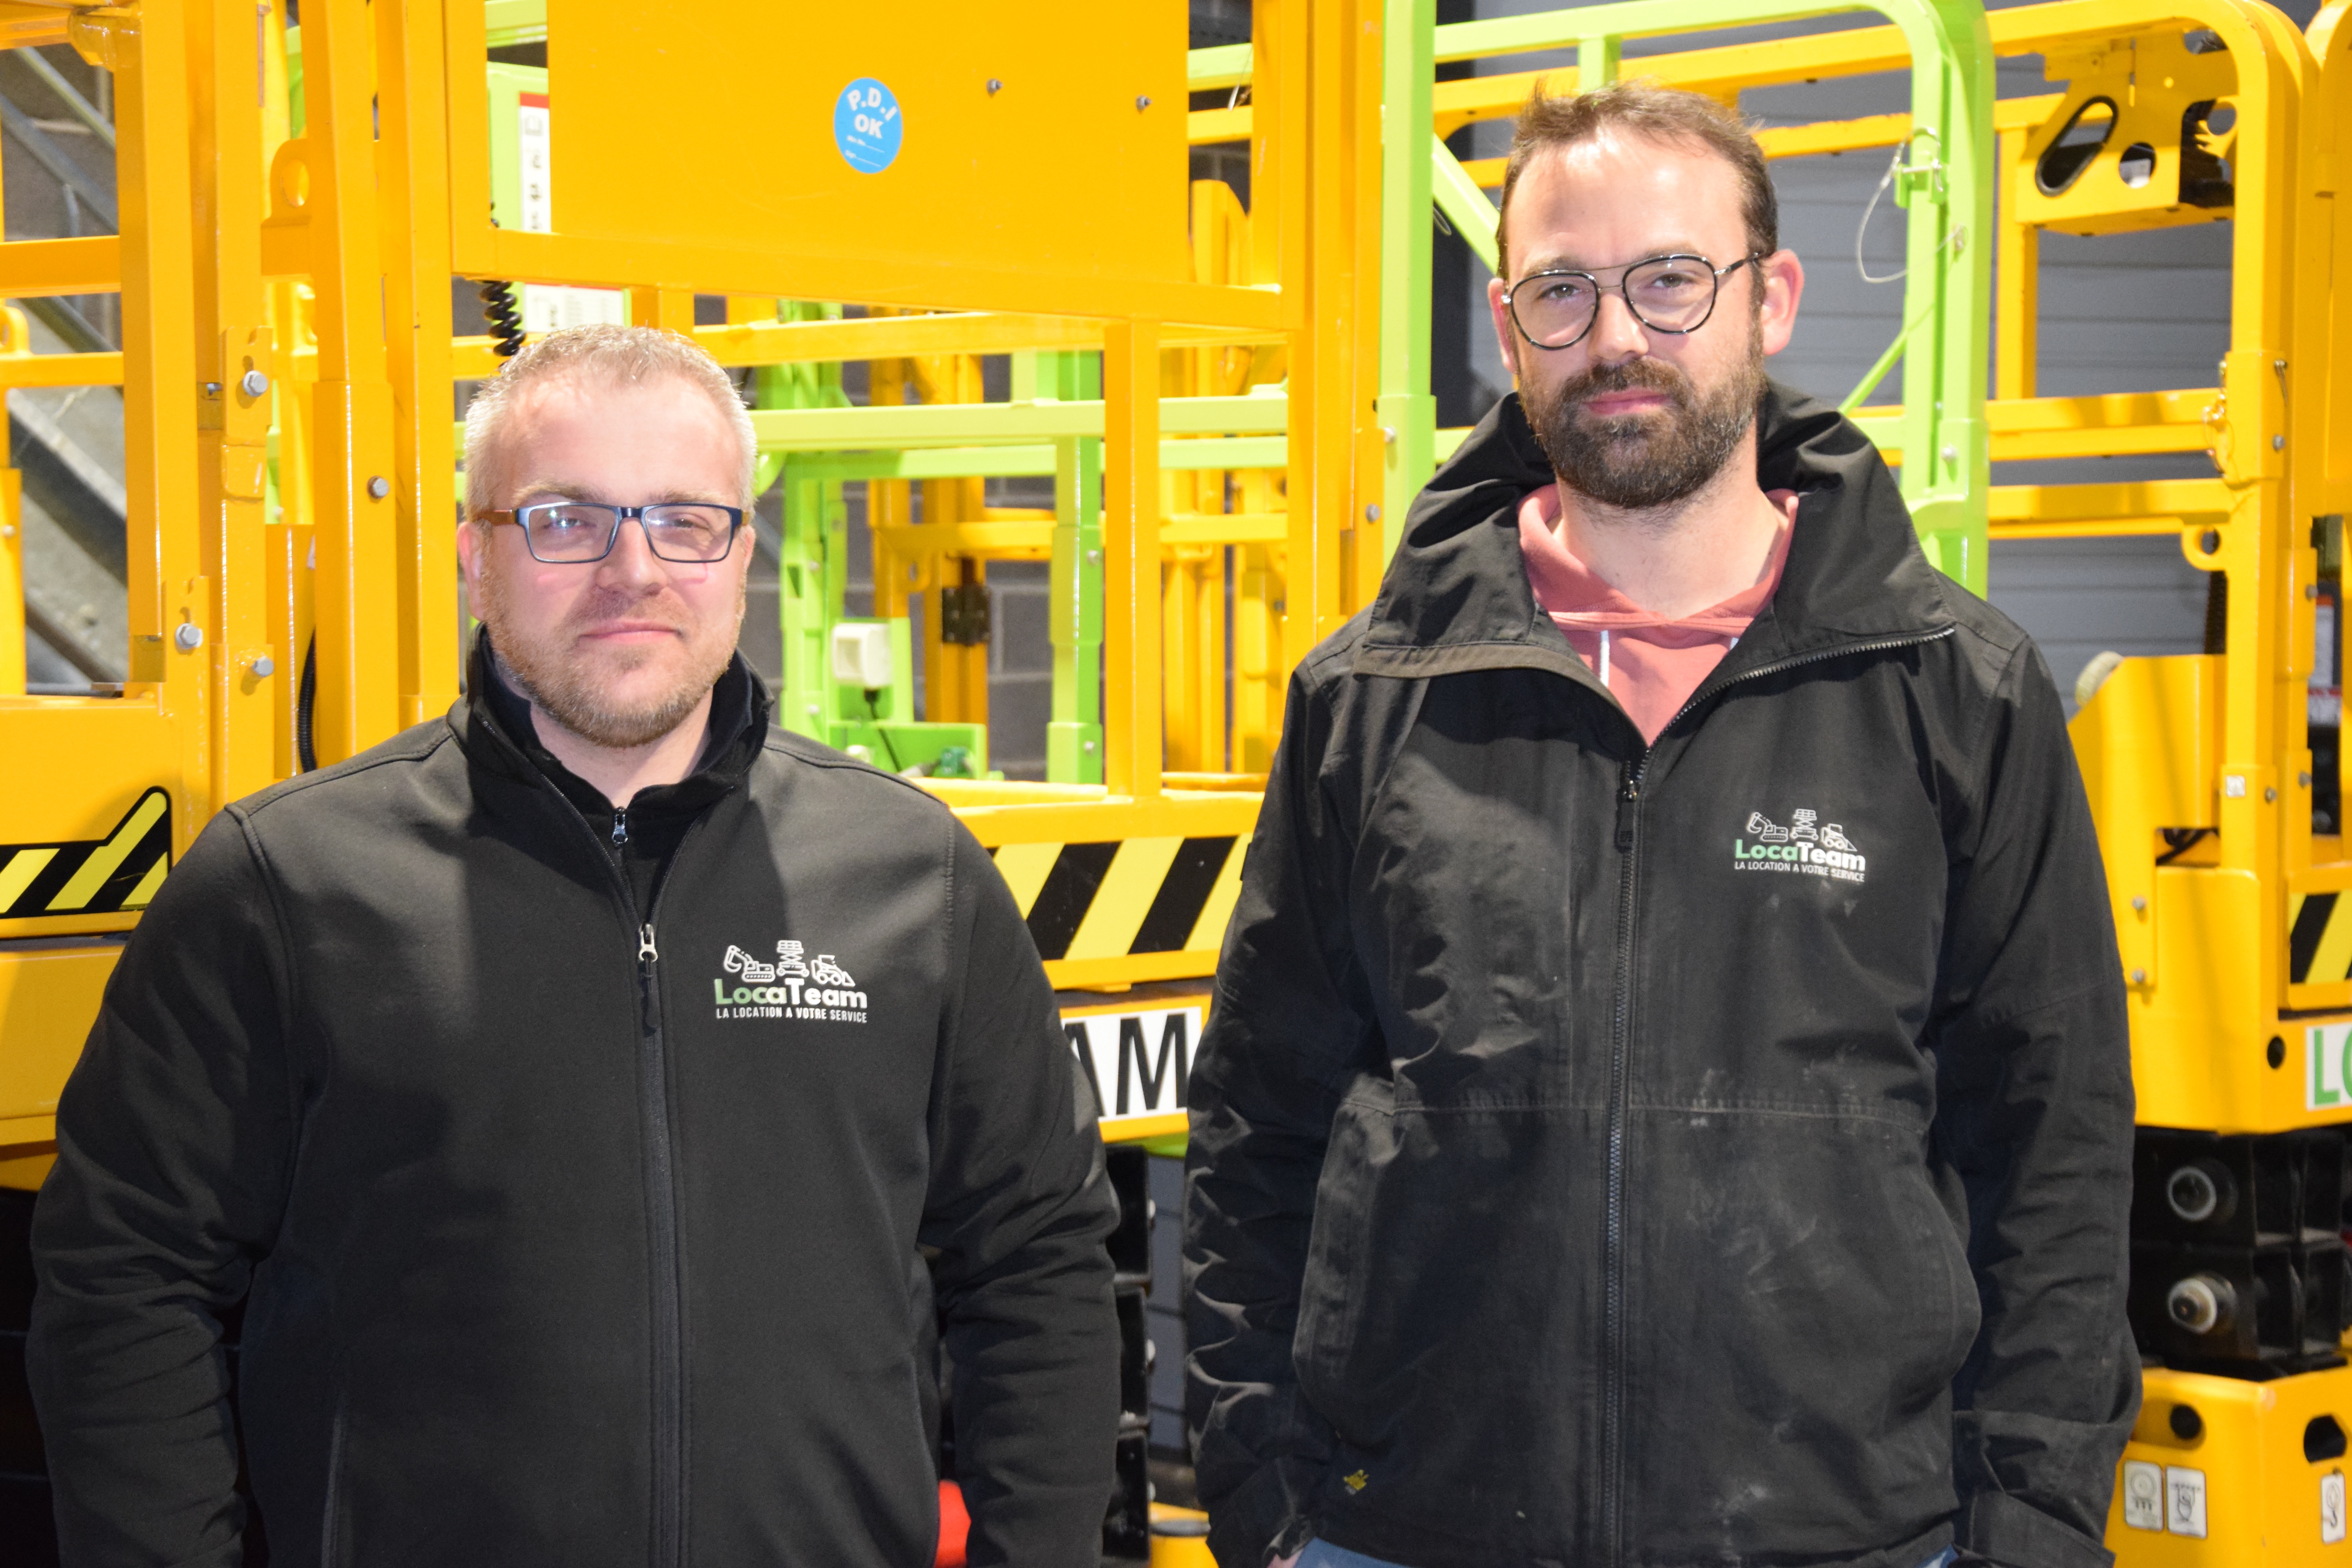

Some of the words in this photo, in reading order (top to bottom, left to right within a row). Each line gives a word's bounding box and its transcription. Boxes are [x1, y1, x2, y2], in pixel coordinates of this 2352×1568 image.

[854, 113, 884, 139] OK
[1735, 838, 1866, 871] LocaTeam
[1735, 861, 1746, 870] LA
[1748, 861, 1791, 872] LOCATION
[1793, 864, 1799, 872] A
[1803, 864, 1829, 876] VOTRE
[1831, 869, 1865, 882] SERVICE
[714, 978, 867, 1009] LocaTeam
[716, 1008, 730, 1019] LA
[733, 1007, 782, 1018] LOCATION
[786, 1007, 793, 1018] A
[795, 1007, 827, 1020] VOTRE
[829, 1010, 867, 1023] SERVICE
